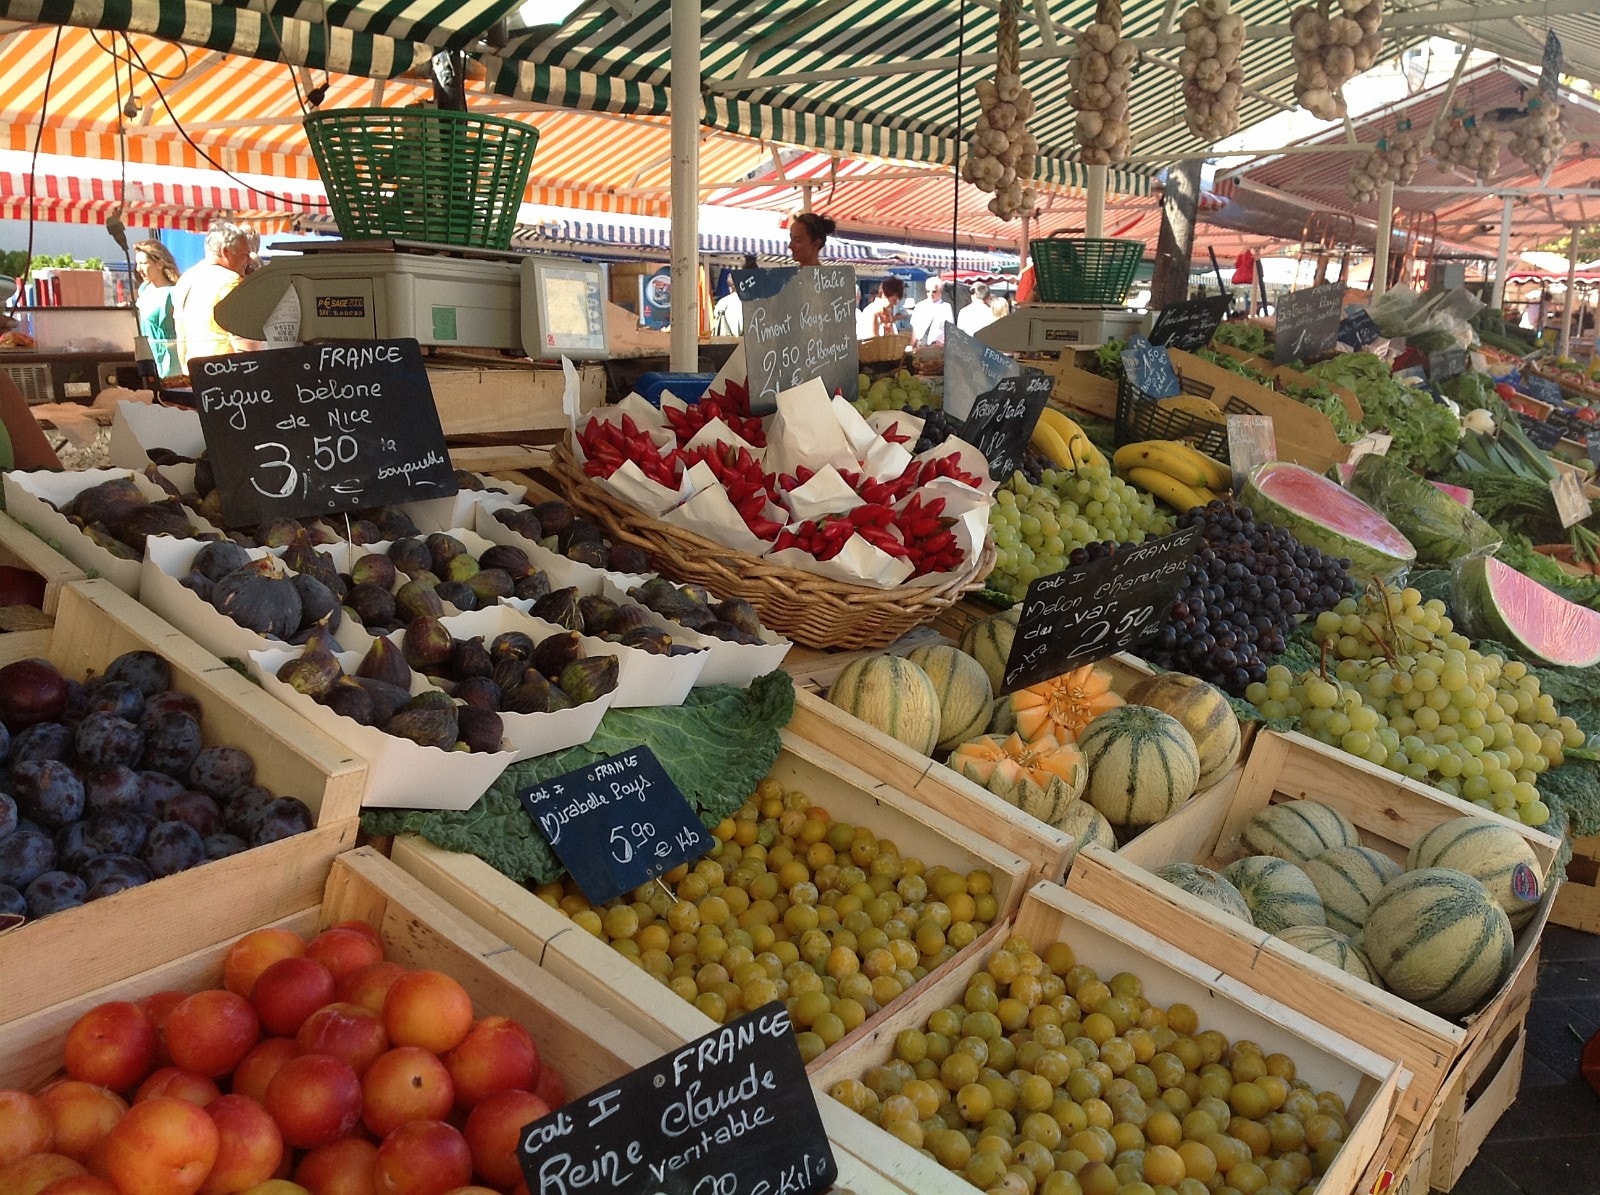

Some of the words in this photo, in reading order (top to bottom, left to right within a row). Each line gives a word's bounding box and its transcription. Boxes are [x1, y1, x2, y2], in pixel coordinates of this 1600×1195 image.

[748, 307, 792, 343] Piment
[800, 302, 831, 333] Rouge
[318, 346, 403, 372] FRANCE
[201, 386, 274, 431] Figue
[276, 414, 310, 430] de
[1123, 533, 1195, 566] FRANCE
[1025, 595, 1083, 622] Melon
[1093, 559, 1188, 600] Charentais
[1024, 623, 1053, 640] du
[594, 754, 638, 782] FRANCE
[539, 792, 610, 845] Mirabelle
[672, 1009, 792, 1087] FRANCE
[538, 1139, 644, 1195] Reine
[660, 1061, 777, 1138] Claude
